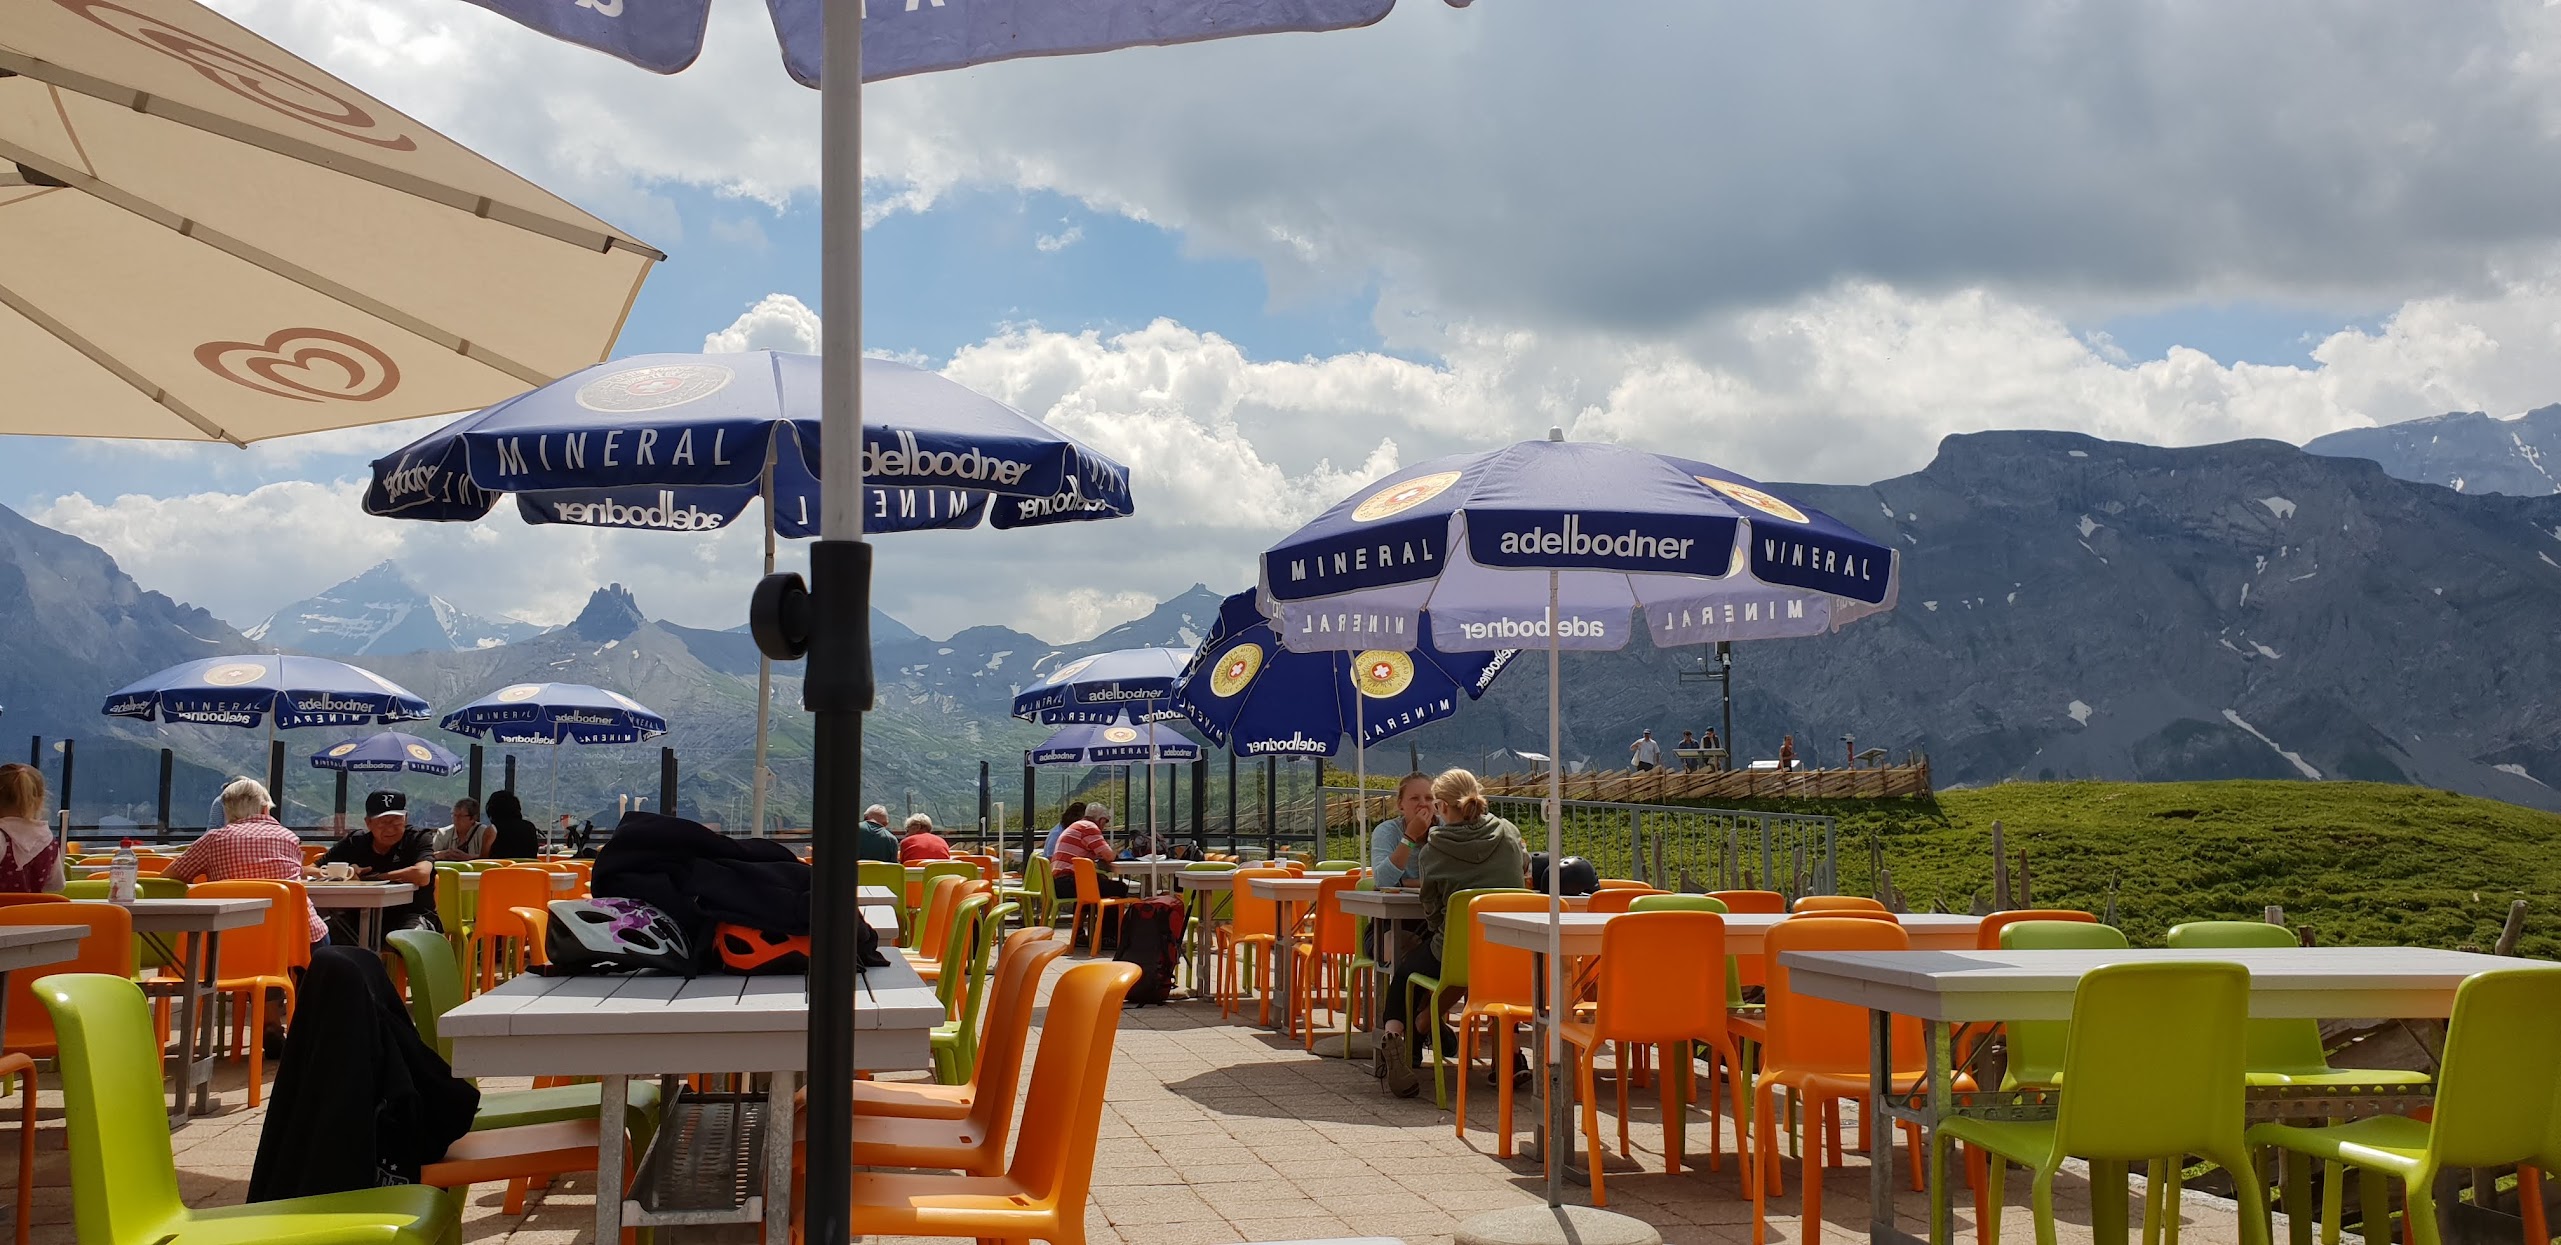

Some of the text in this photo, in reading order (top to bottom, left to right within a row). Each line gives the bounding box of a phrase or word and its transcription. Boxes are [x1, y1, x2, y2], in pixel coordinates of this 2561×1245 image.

[497, 428, 731, 476] MINERAL
[863, 430, 1032, 485] delbodner
[1501, 514, 1694, 560] adelbodner
[1291, 538, 1432, 581] MINERAL
[1089, 683, 1163, 702] adelbodner
[176, 701, 260, 711] MINERAL
[299, 693, 375, 713] adelbodner
[555, 710, 613, 724] adelbodner
[1039, 749, 1076, 761] adelbodner
[1097, 748, 1149, 757] MINERAL
